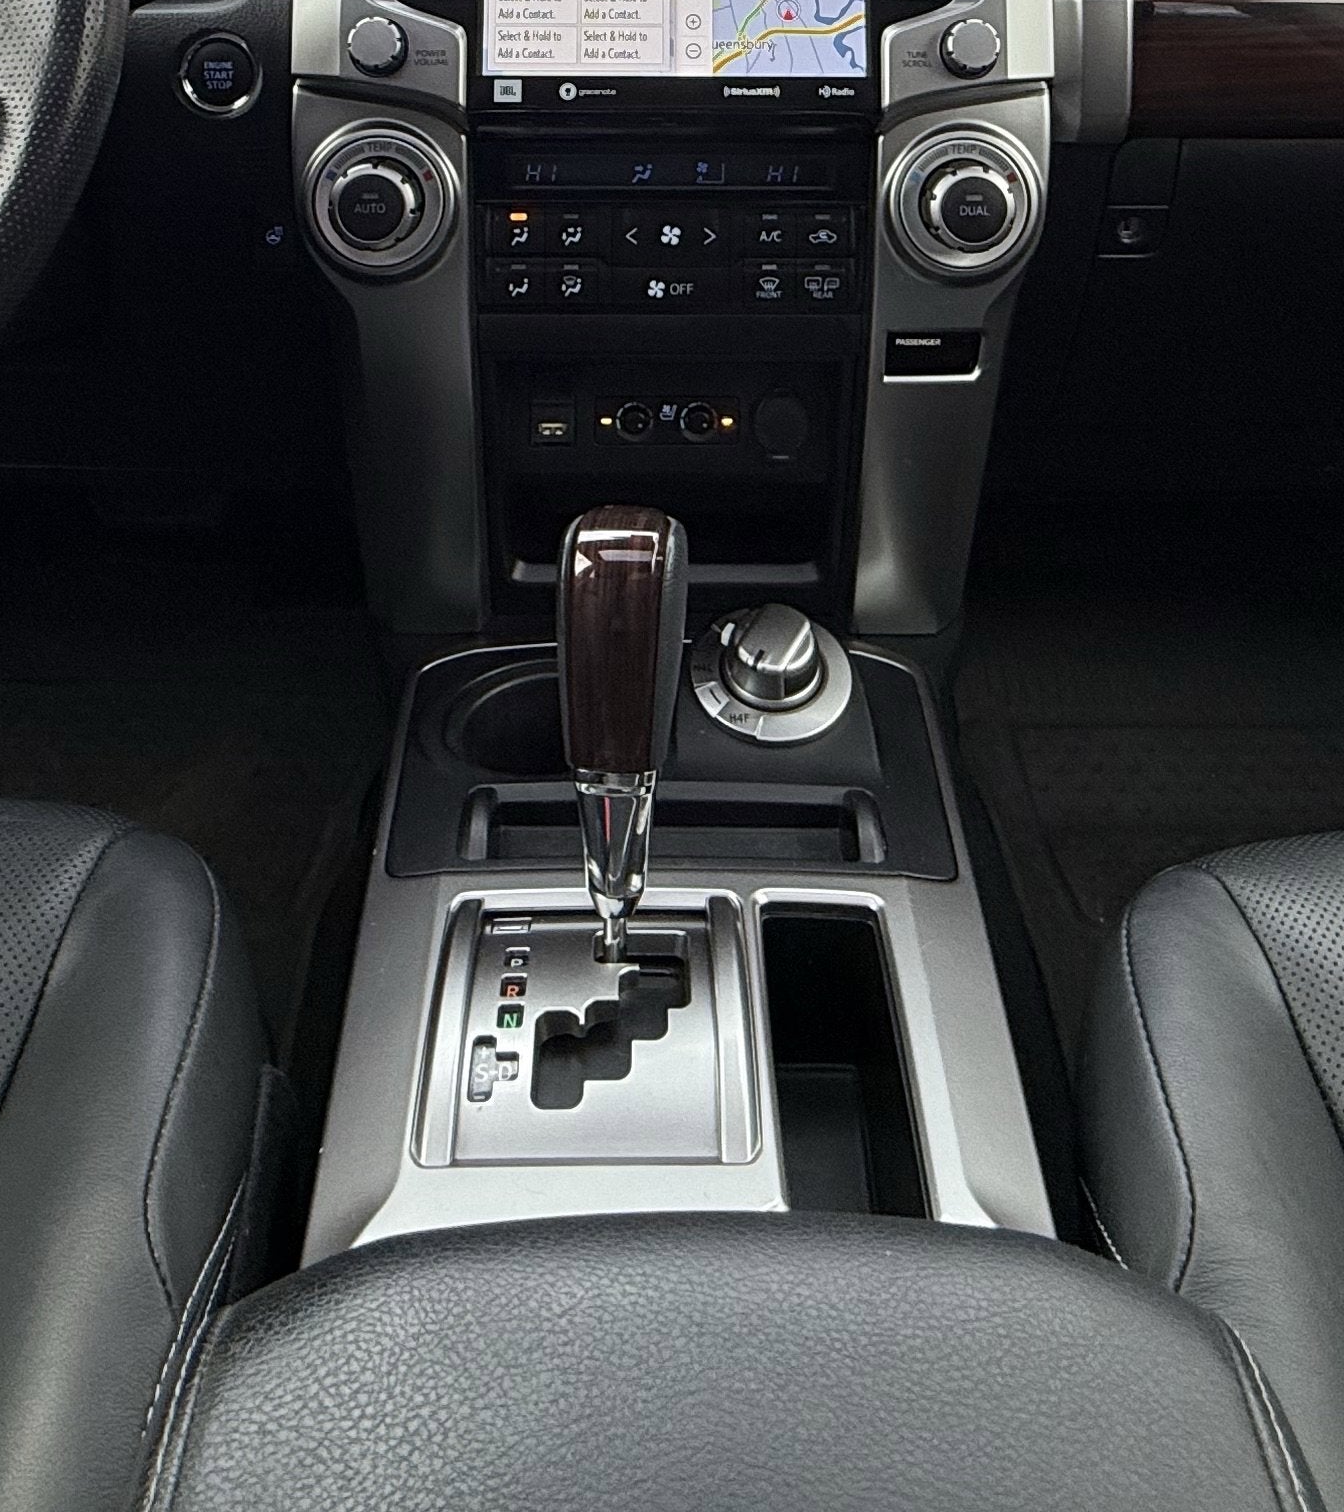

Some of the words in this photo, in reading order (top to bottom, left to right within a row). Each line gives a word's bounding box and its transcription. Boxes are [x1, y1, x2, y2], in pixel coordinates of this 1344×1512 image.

[498, 8, 514, 20] Add
[516, 11, 521, 20] a
[583, 8, 600, 20] Add
[601, 11, 607, 20] a
[497, 30, 522, 42] Select
[523, 30, 530, 42] &
[532, 30, 551, 42] Hold
[553, 30, 562, 42] to
[583, 30, 607, 42] Select
[609, 30, 616, 42] &
[618, 30, 637, 42] Hold
[638, 30, 648, 42] to
[712, 40, 775, 55] ueensbury
[416, 49, 446, 58] POWER
[497, 48, 514, 59] Add
[515, 51, 520, 59] a
[583, 48, 600, 60] Add
[601, 51, 606, 60] a
[906, 50, 928, 59] TUNE
[414, 58, 448, 67] VOLUME
[204, 70, 234, 79] START
[206, 80, 232, 90] STOP
[499, 85, 517, 97] JBL
[578, 88, 617, 97] gracenote
[354, 203, 386, 213] AUTO
[959, 206, 990, 216] DUAL
[759, 230, 782, 243] A/C
[669, 283, 694, 295] OFF
[756, 290, 782, 299] FRONT
[812, 290, 834, 299] REAR
[895, 338, 941, 346] PASSENGER
[729, 713, 749, 724] H4F
[510, 957, 524, 968] P
[506, 985, 520, 998] R
[503, 1013, 519, 1028] N
